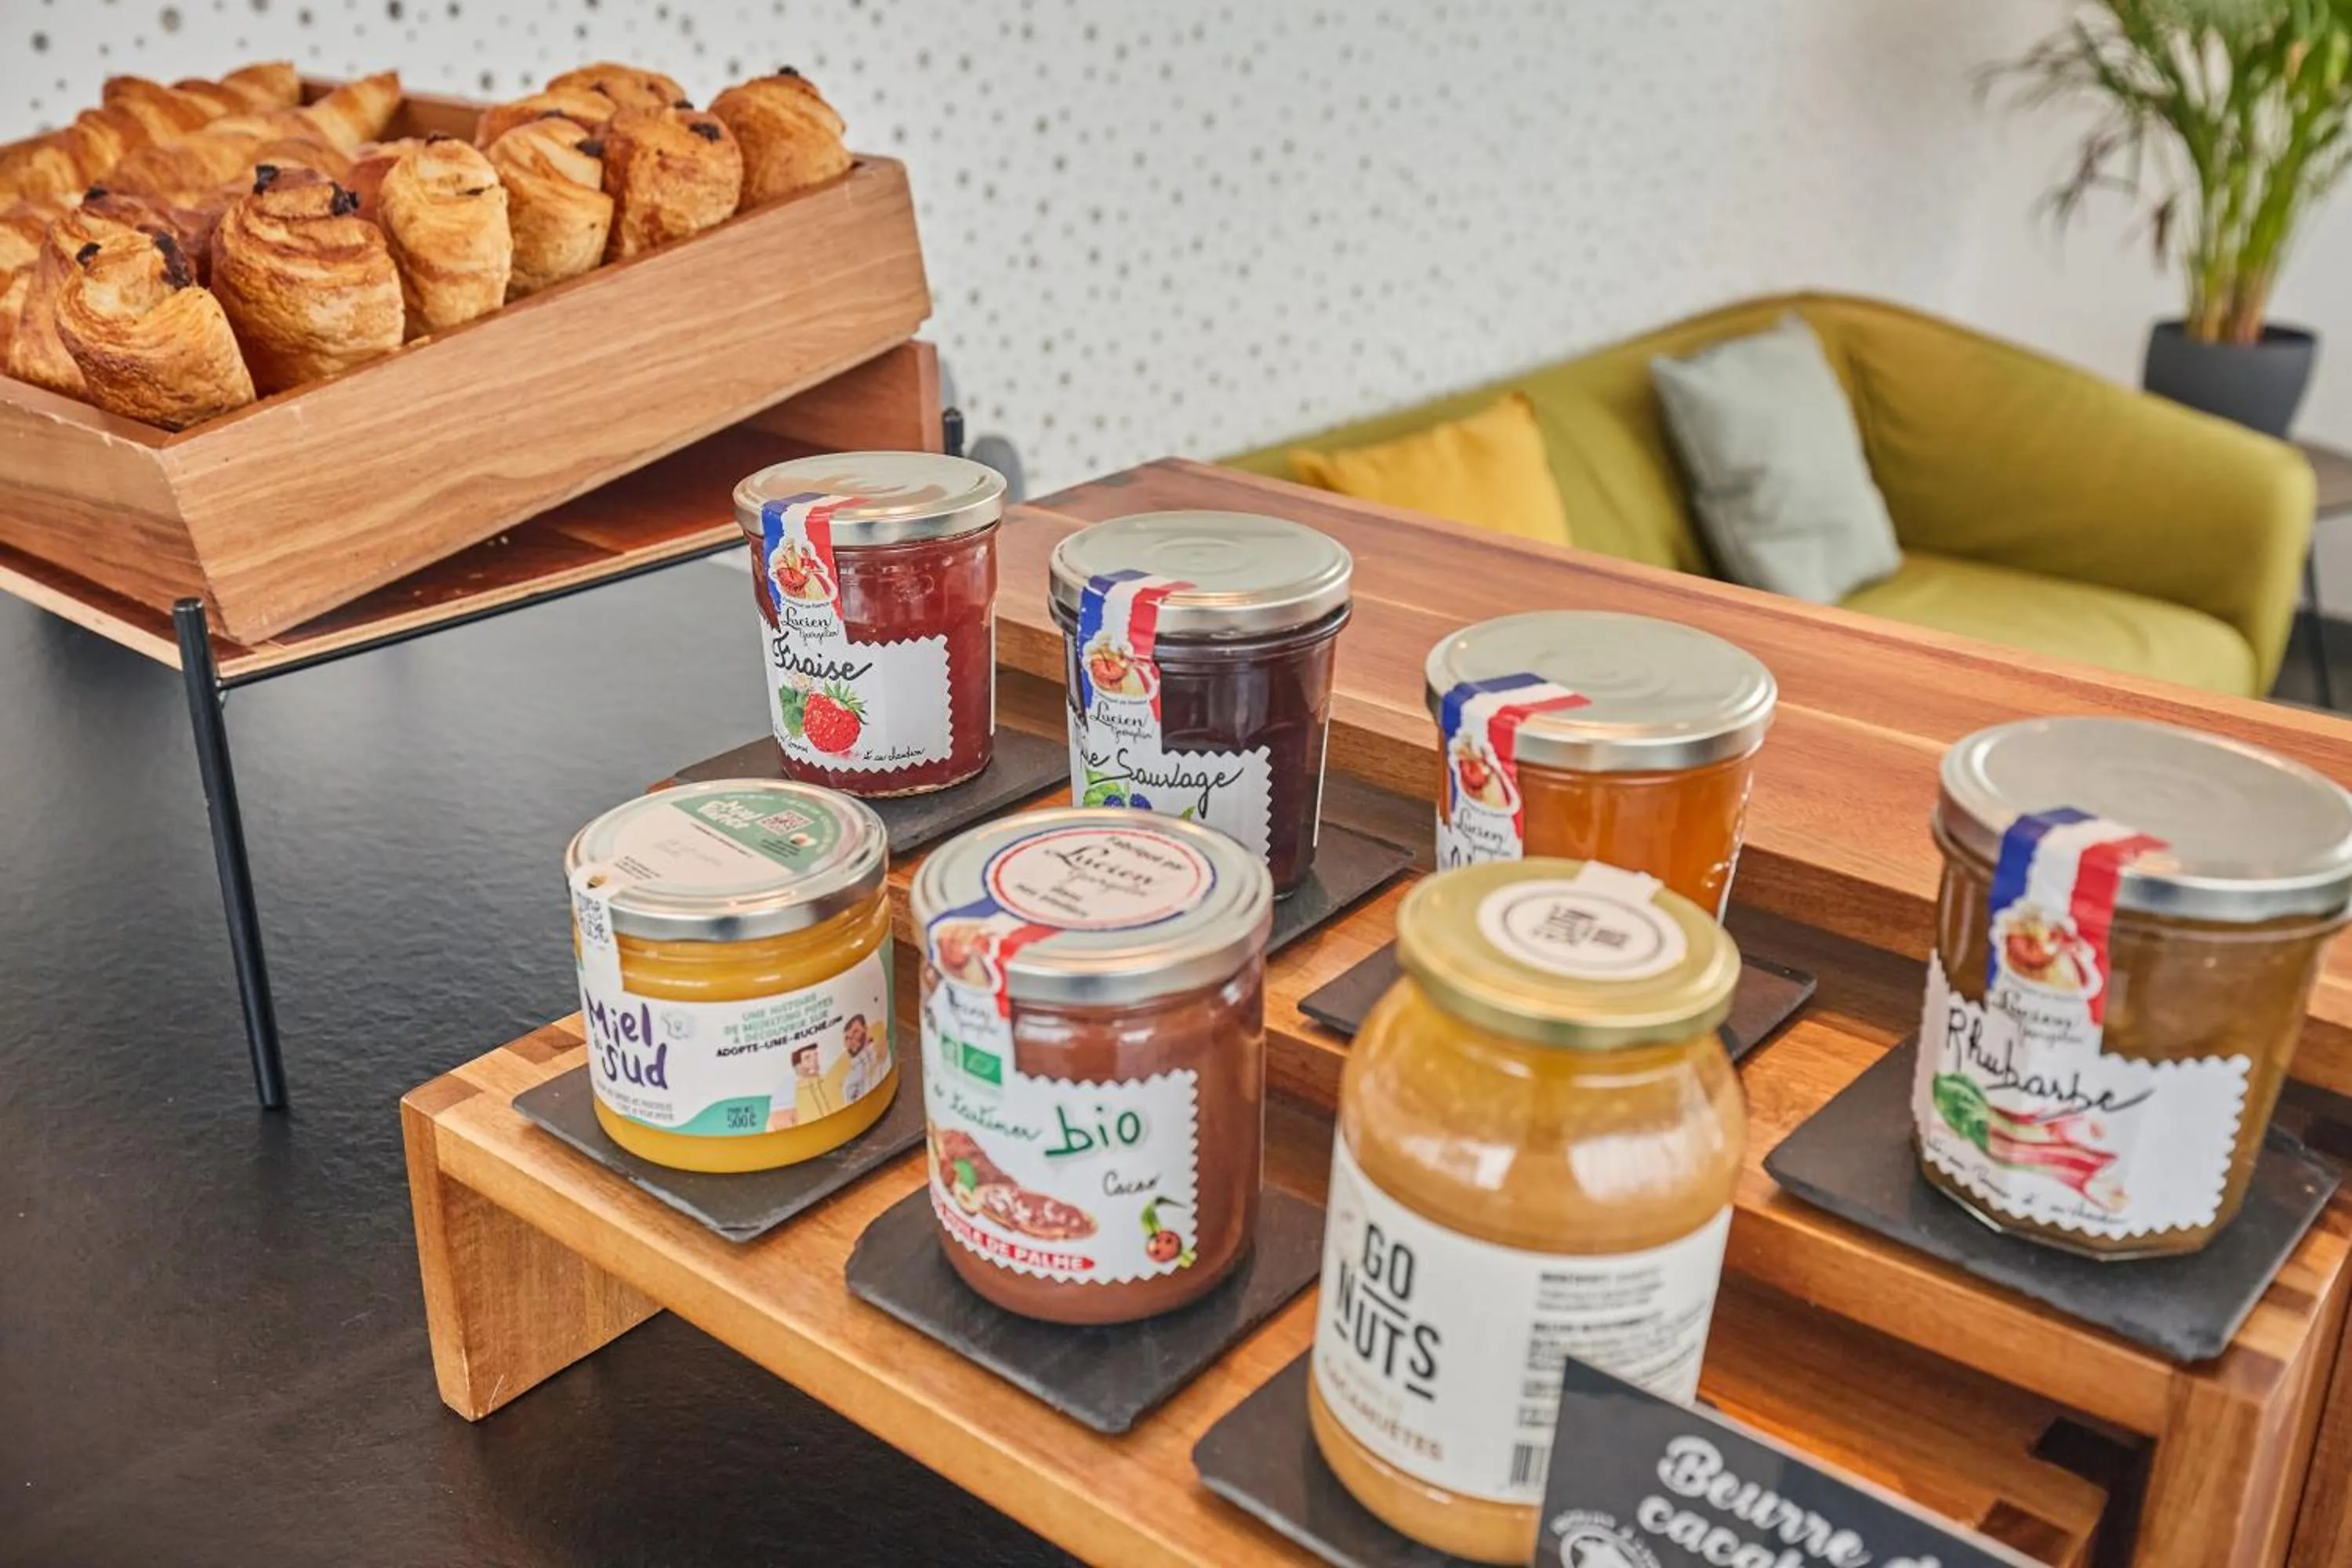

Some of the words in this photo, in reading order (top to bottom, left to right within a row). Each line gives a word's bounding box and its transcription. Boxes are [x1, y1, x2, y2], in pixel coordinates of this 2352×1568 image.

[781, 606, 833, 630] Lucien
[772, 630, 873, 681] Fraise
[1090, 700, 1149, 728] Lucien
[1090, 747, 1245, 819] Sauvage
[585, 986, 652, 1048] Miel
[601, 1042, 669, 1091] Sud
[1947, 1007, 2156, 1112] Rhubarbe
[1044, 1105, 1141, 1156] bio
[1102, 1171, 1162, 1196] Cacao
[1361, 1221, 1416, 1302] GO
[1336, 1259, 1443, 1382] NUTS
[1656, 1434, 1874, 1568] Beurre
